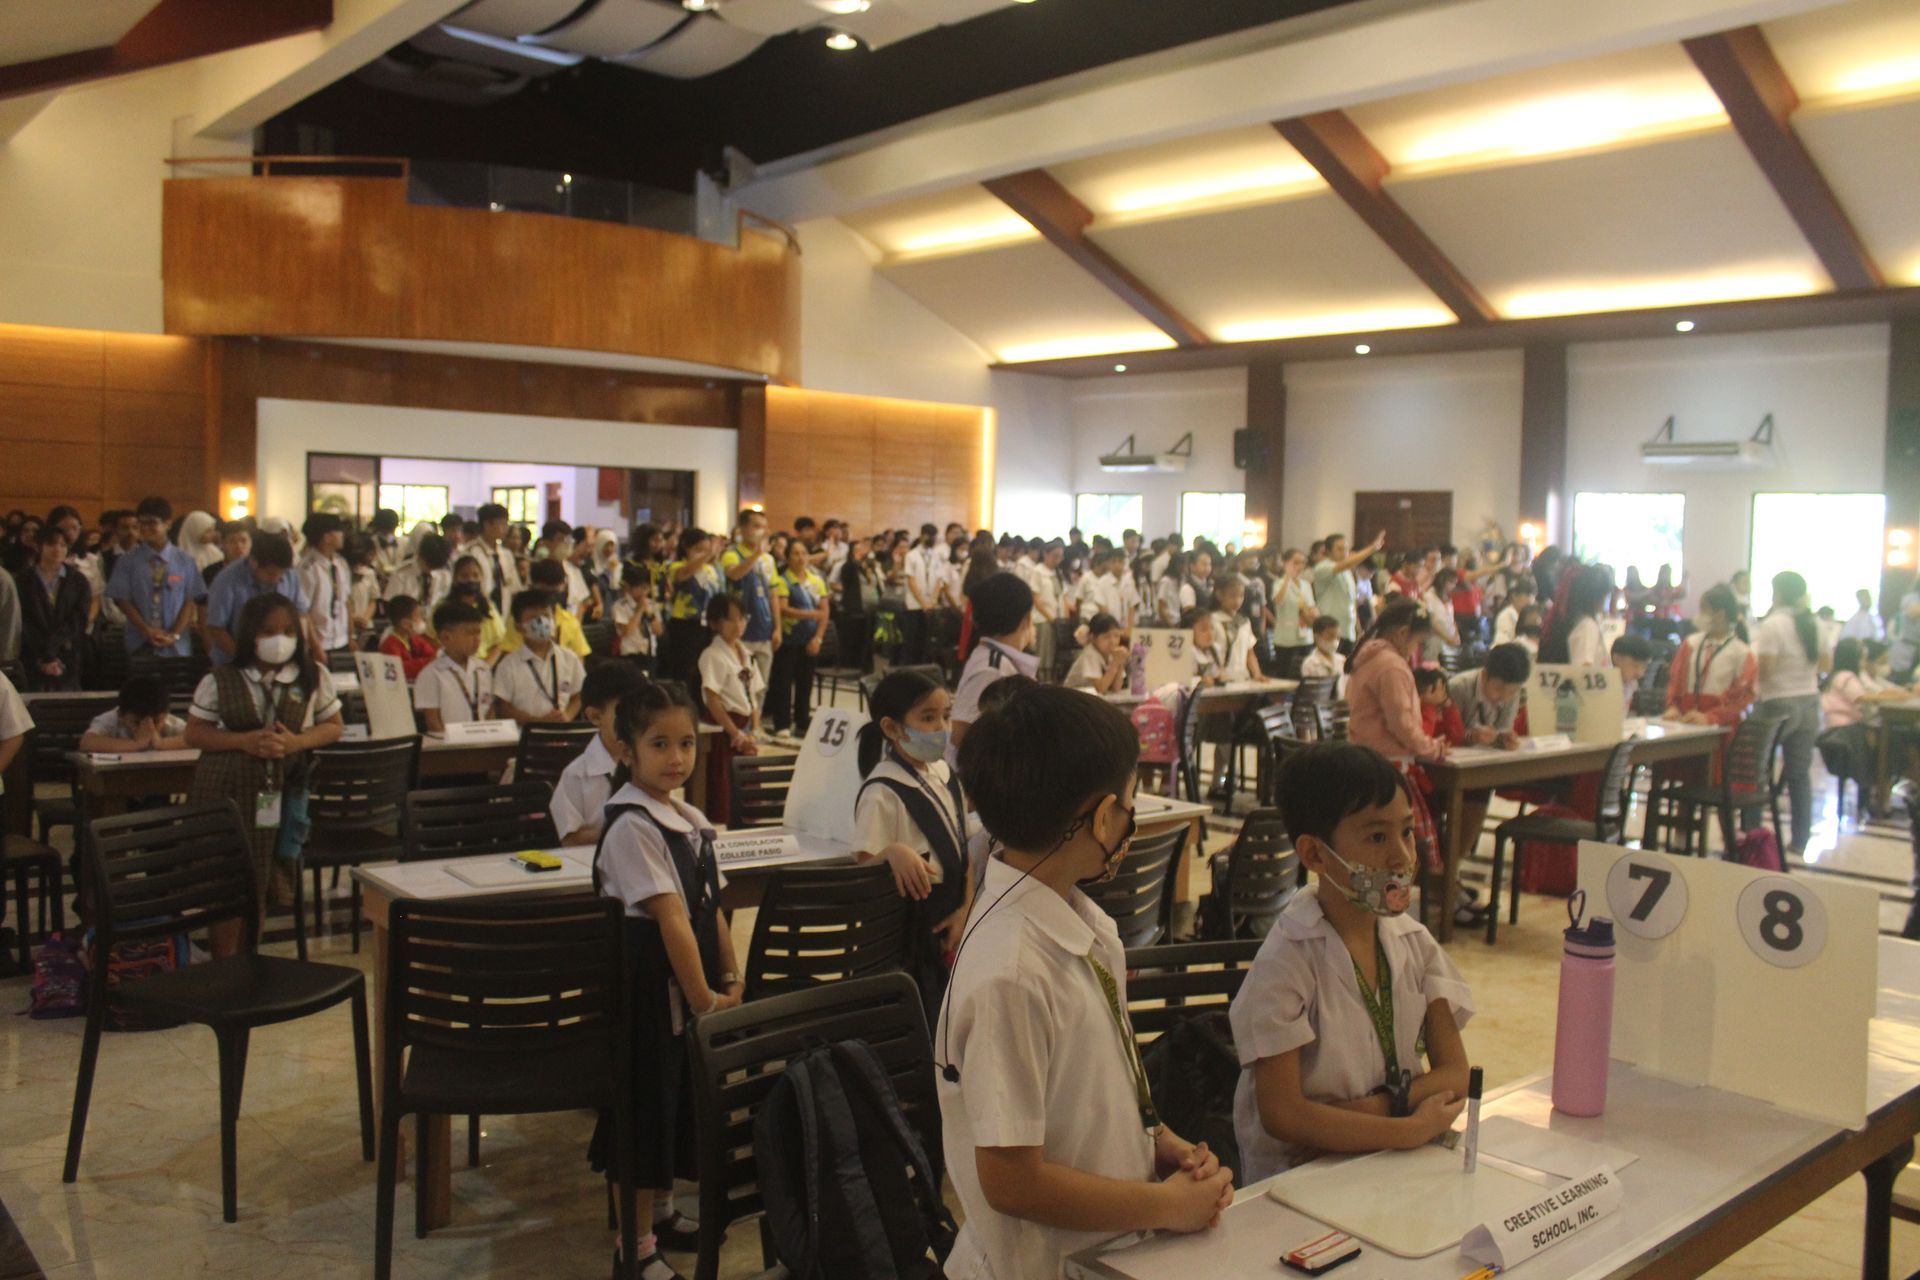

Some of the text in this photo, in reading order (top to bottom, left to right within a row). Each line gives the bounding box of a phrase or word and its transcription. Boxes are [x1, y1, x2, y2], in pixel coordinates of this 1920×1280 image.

[1167, 634, 1185, 649] 27
[1539, 672, 1607, 690] 17 18
[819, 717, 849, 747] 15
[715, 837, 784, 850] LA CONSOLACION
[720, 849, 757, 860] COLLEGE
[1628, 862, 1805, 952] 7 8
[1503, 1172, 1609, 1233] CREATIVE LEARNING
[1531, 1204, 1599, 1249] SCHOOL, INC.
